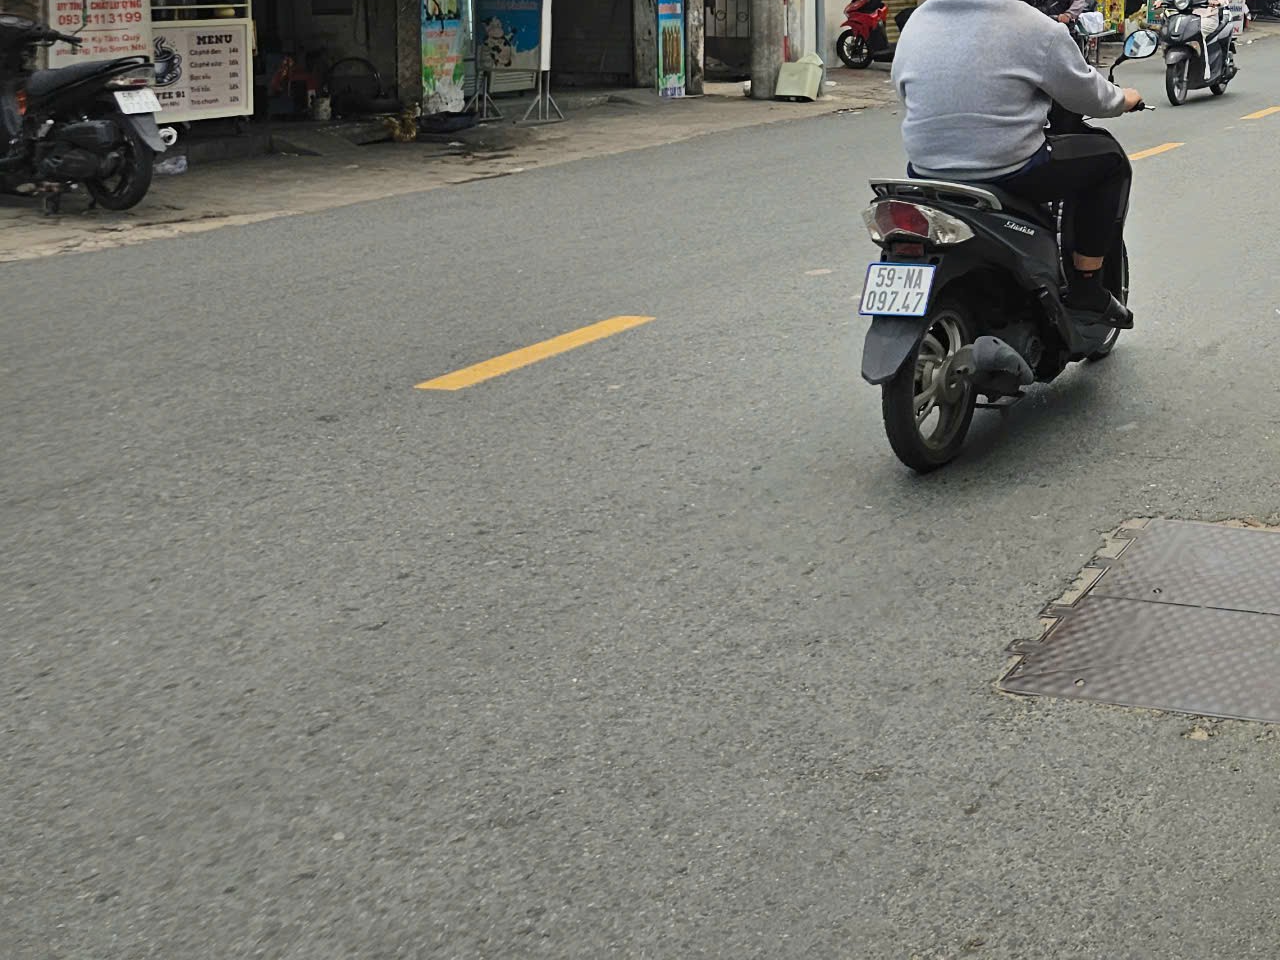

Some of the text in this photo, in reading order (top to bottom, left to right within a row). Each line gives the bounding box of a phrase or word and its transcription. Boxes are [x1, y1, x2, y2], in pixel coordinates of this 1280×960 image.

[196, 34, 233, 45] MENU
[875, 267, 924, 290] 59-NA
[865, 290, 925, 314] 097.47
